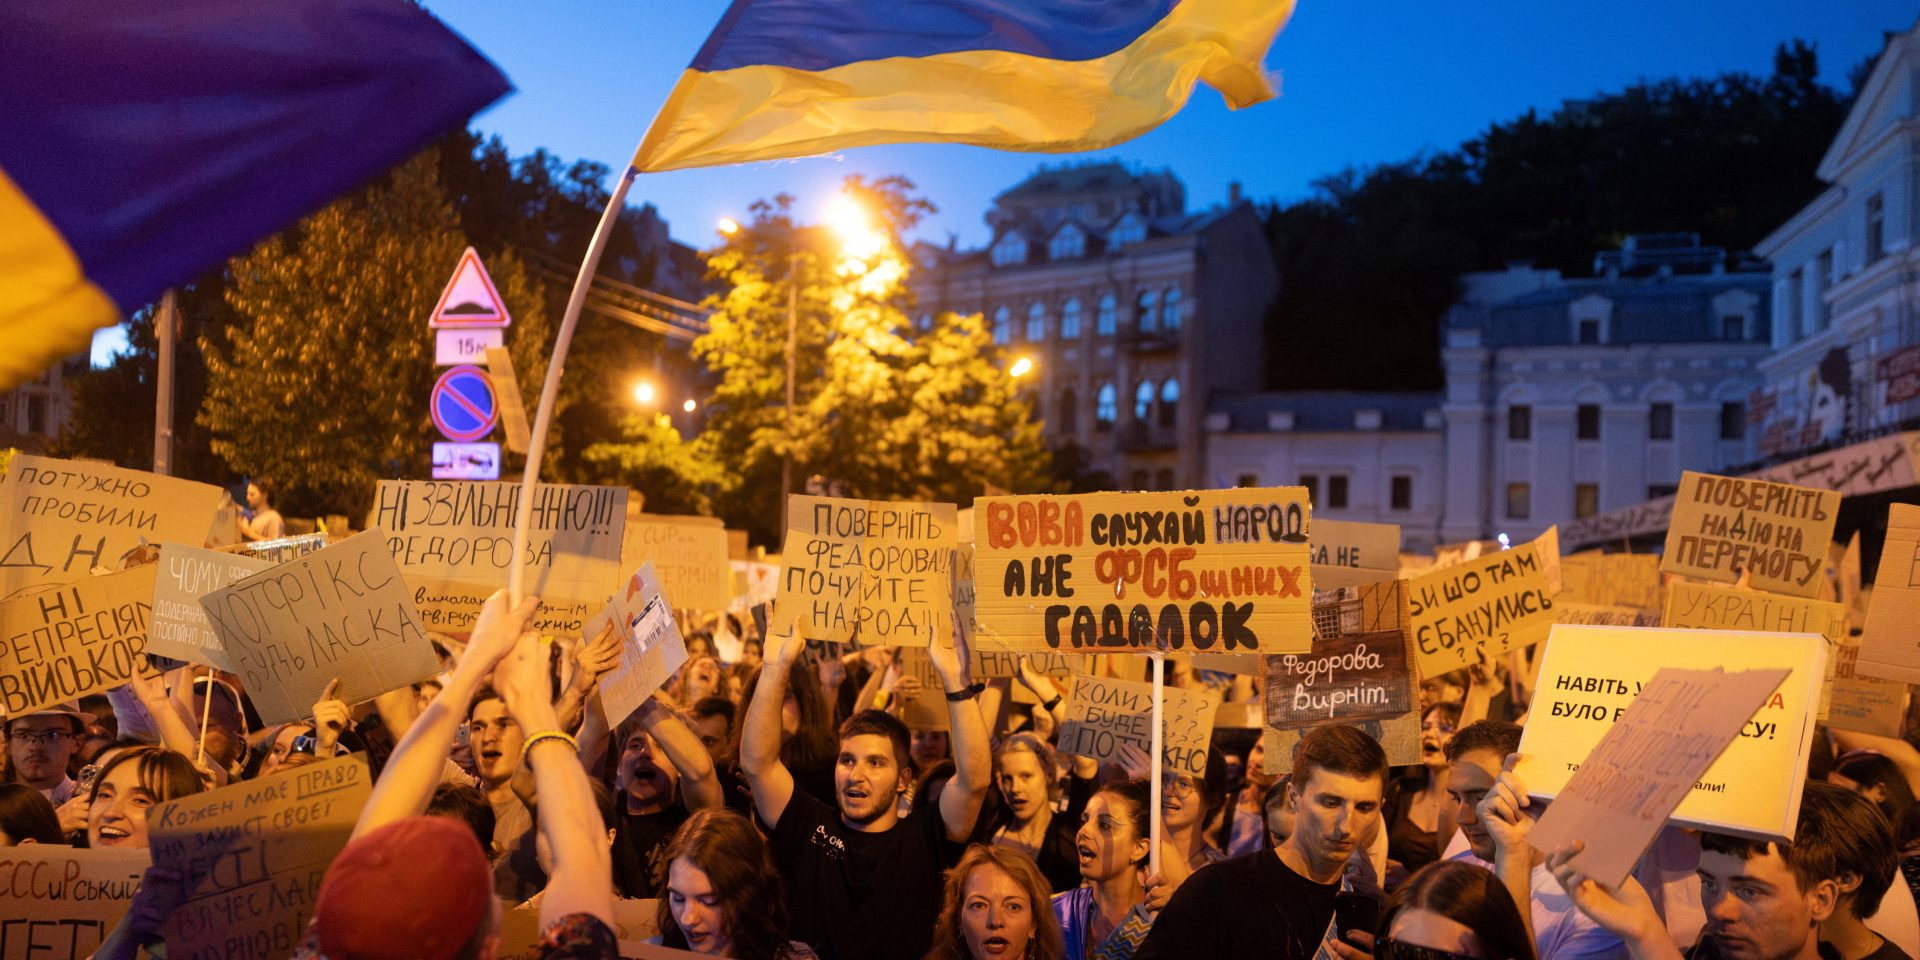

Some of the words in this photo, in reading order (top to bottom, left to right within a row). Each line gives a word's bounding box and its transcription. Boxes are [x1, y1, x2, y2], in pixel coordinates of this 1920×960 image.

[19, 467, 151, 498] ПОТУЖНО
[22, 496, 158, 530] ПРОБИЛИ
[377, 482, 411, 531] НІ
[987, 499, 1084, 549] ВОВА
[1091, 495, 1205, 547] СЛУХАЙ
[1212, 501, 1309, 544] НАРОД
[170, 556, 222, 594] ЧОМУ
[1337, 546, 1359, 567] НЕ
[1676, 535, 1823, 587] ПЕРЕМОГУ
[787, 566, 929, 603] ПОЧУЙТЕ
[1443, 571, 1481, 603] ШО
[1485, 552, 1537, 585] ТАМ
[39, 587, 84, 624] НІ
[155, 599, 208, 625] ДОДЕРЖАН
[205, 551, 394, 650] ХОТФІКС
[1681, 589, 1809, 633] УКРАЇНІ
[306, 603, 423, 668] ЛАСКА
[1044, 601, 1259, 650] ГАДАЛОК
[1416, 589, 1553, 655] ЄБАНУЛИСЬ
[0, 633, 150, 713] ВІЙСЬКОВ
[980, 652, 1070, 676] НАОД
[1283, 644, 1385, 686] Федорова
[1074, 681, 1139, 710] КОЛИ
[1556, 675, 1628, 695] НАВІТЬ
[1085, 707, 1147, 736] БУДЕ
[1551, 702, 1607, 721] БУЛО
[297, 764, 358, 798] ПРАВО
[0, 918, 105, 960] ГЕТ
